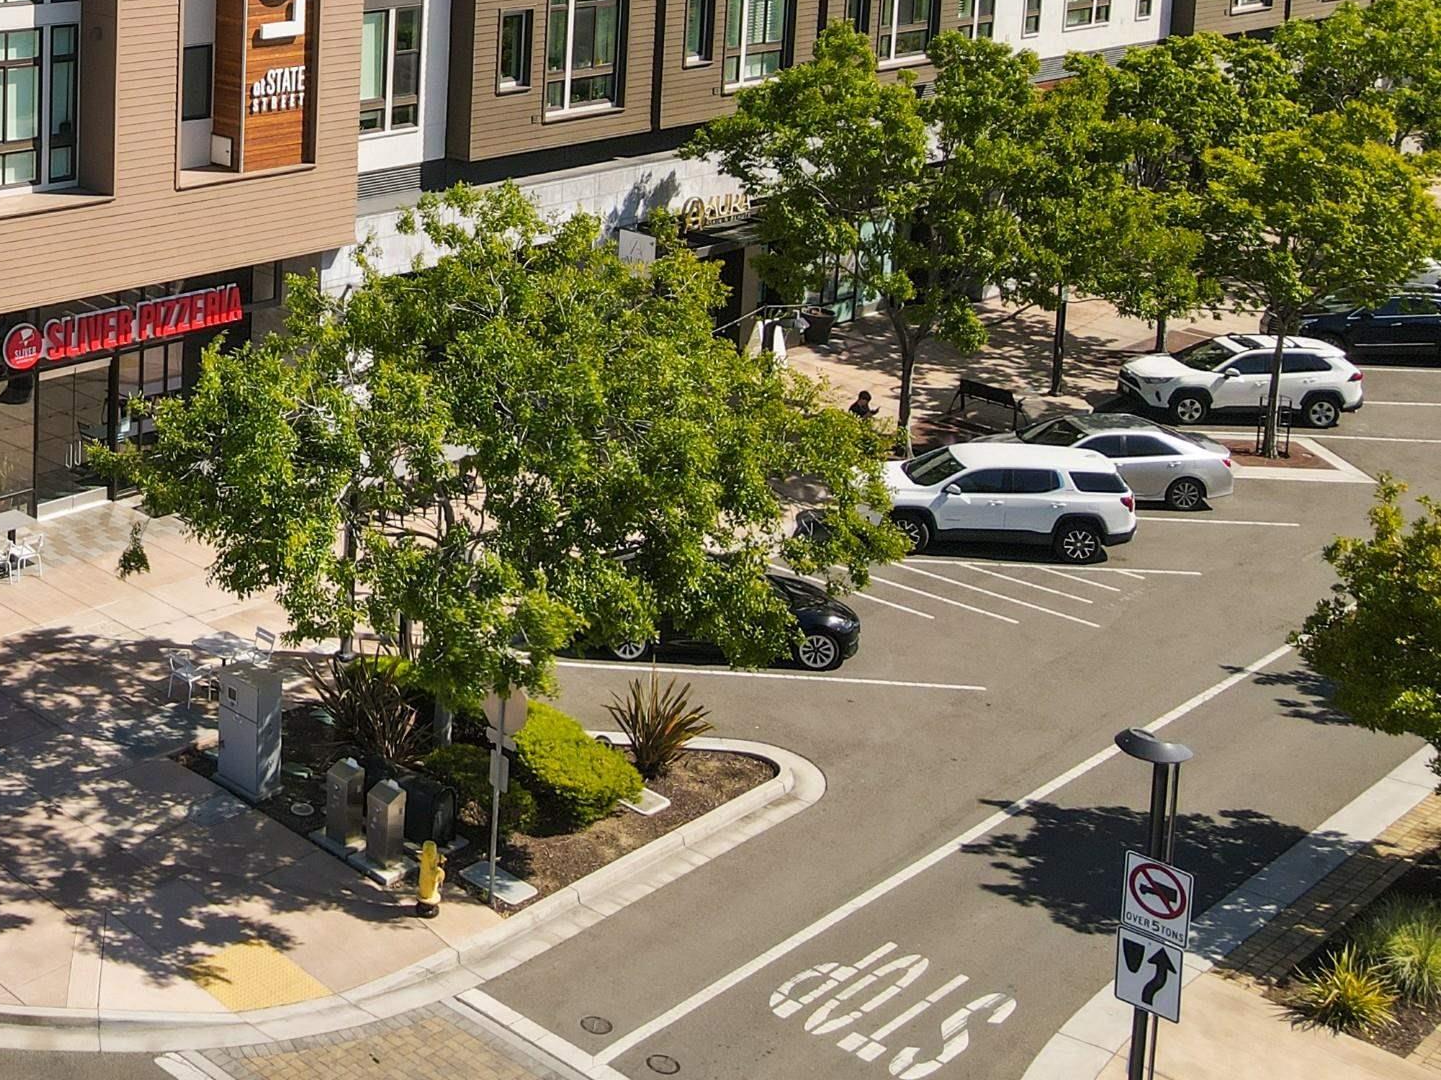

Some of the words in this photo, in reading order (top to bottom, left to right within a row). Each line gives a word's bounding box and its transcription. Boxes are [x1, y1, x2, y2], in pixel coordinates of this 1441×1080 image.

[266, 65, 305, 95] STATE
[252, 92, 304, 112] STREET
[45, 306, 134, 360] SLIVER
[137, 283, 243, 341] PIZZERIA
[14, 346, 37, 360] SLIVER
[1126, 911, 1150, 928] OVER
[1151, 920, 1160, 932] 5
[1161, 925, 1184, 942] TONS
[769, 941, 1017, 1080] STOP
